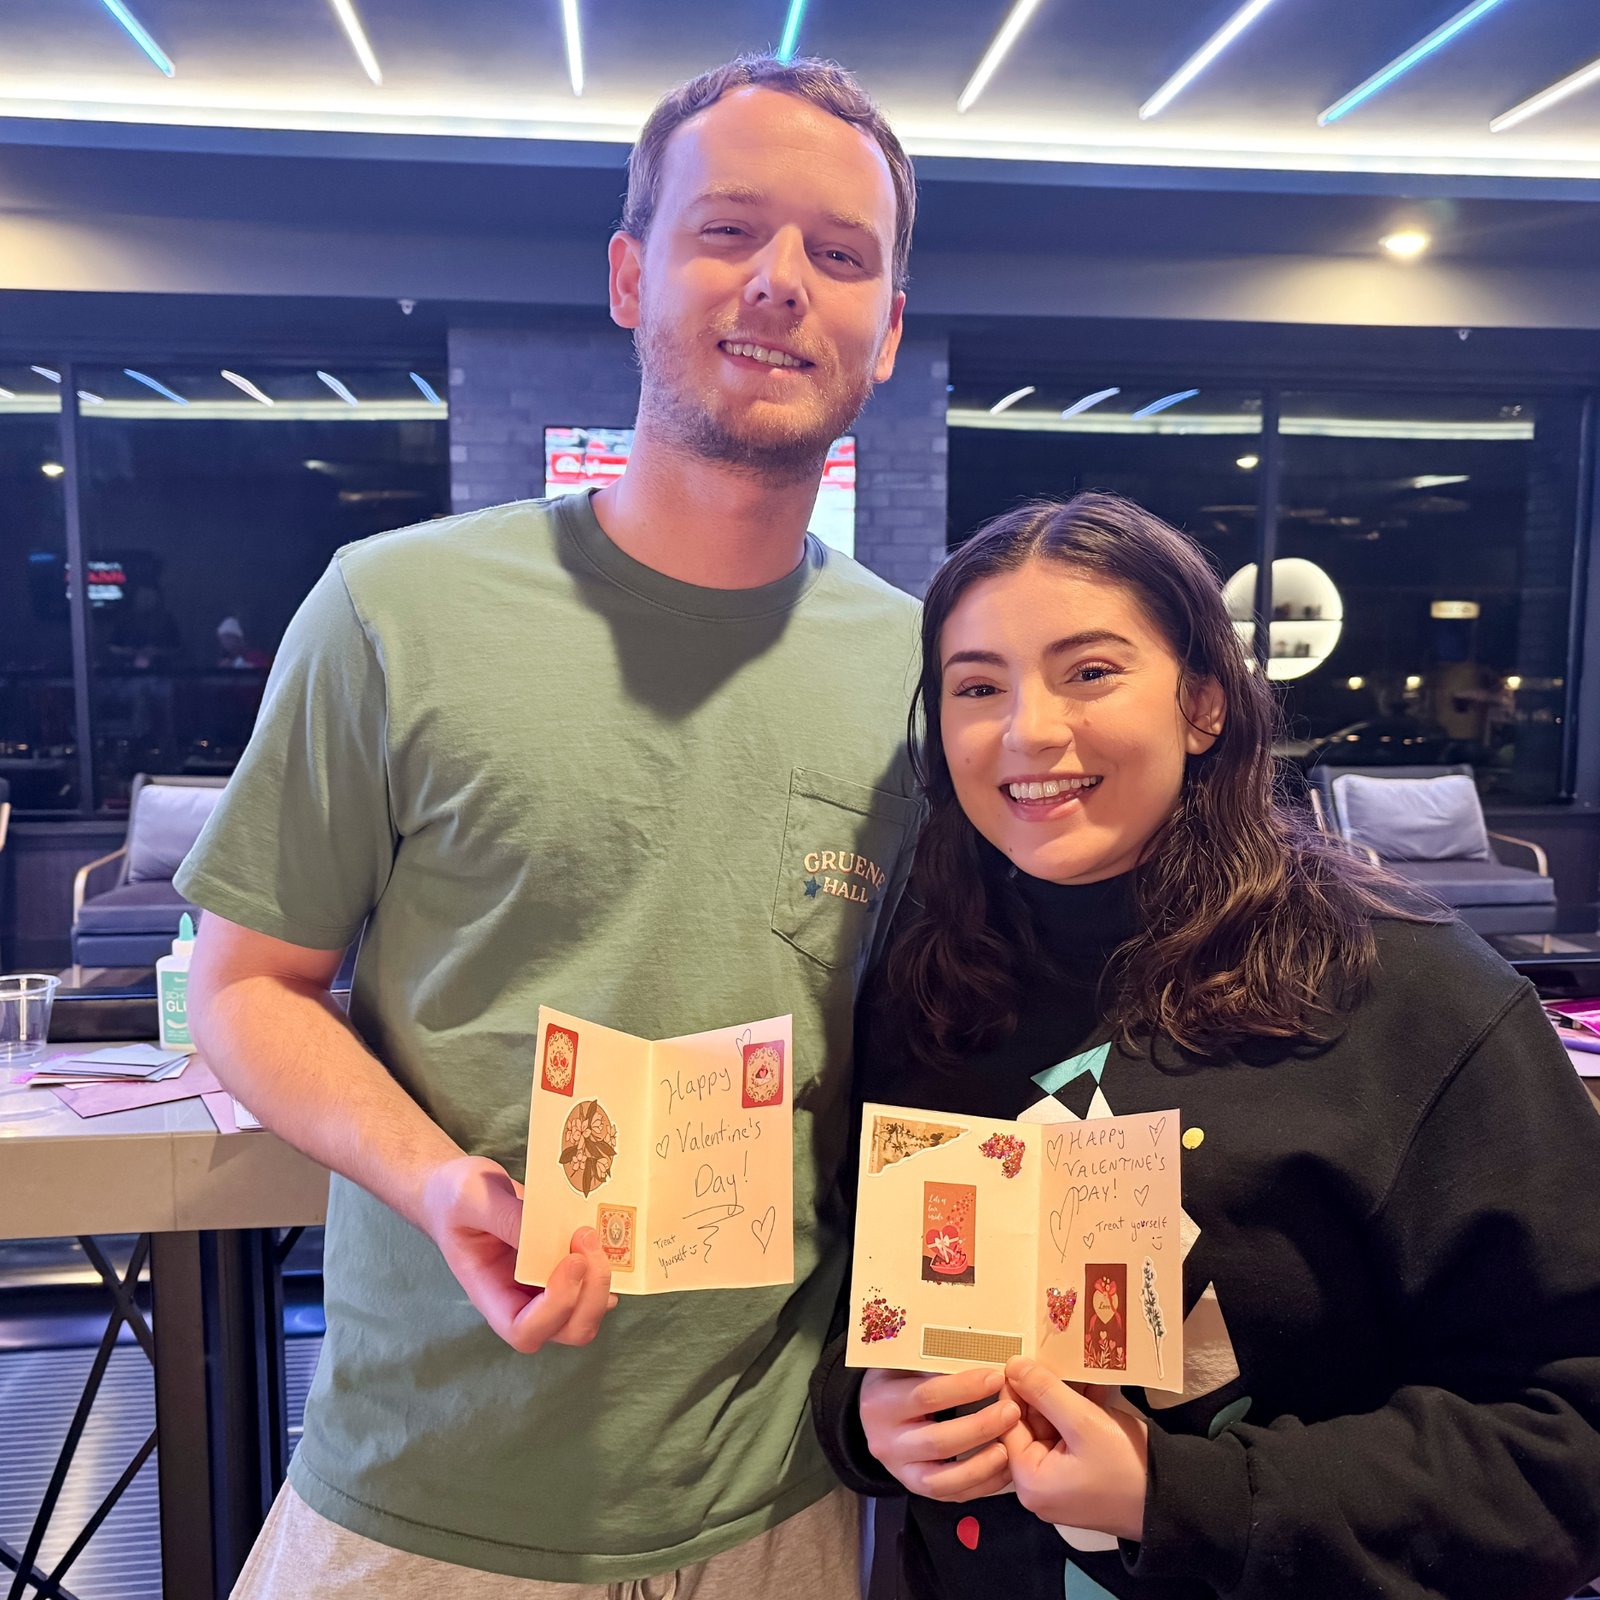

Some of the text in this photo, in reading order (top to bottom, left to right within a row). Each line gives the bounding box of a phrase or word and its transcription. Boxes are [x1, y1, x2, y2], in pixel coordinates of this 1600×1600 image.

[822, 876, 869, 903] HALL
[660, 1068, 731, 1115] Happy
[676, 1117, 761, 1152] Valentine's
[1063, 1152, 1165, 1178] VALENTINE'S
[694, 1150, 748, 1216] Day!
[1074, 1178, 1117, 1214] DAY!
[653, 1235, 676, 1248] Treat
[1095, 1216, 1167, 1242] Treat yourself
